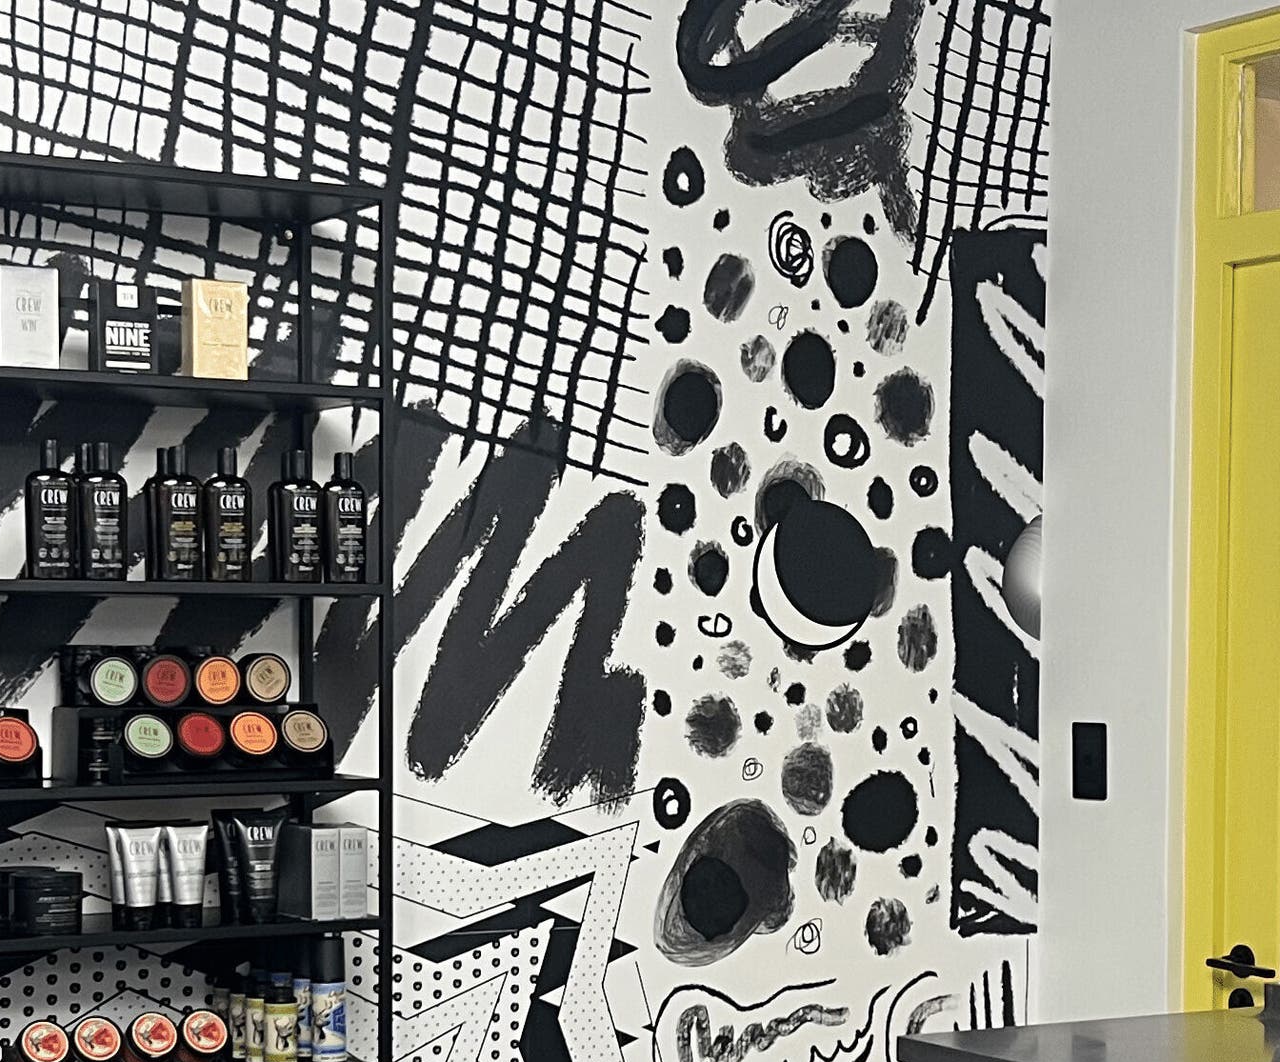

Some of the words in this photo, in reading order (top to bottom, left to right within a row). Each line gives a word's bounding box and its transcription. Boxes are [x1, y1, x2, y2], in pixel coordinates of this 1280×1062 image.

[16, 297, 42, 312] CREW
[209, 298, 233, 313] CREW
[106, 327, 151, 347] NINE
[41, 489, 69, 504] CREW
[94, 491, 120, 506] CREW
[172, 493, 197, 508] CREW
[220, 494, 245, 509] CREW
[294, 496, 317, 511] CREW
[338, 497, 362, 512] CREW
[247, 826, 274, 841] CREW
[129, 840, 156, 856] CREW
[177, 840, 202, 855] CREW
